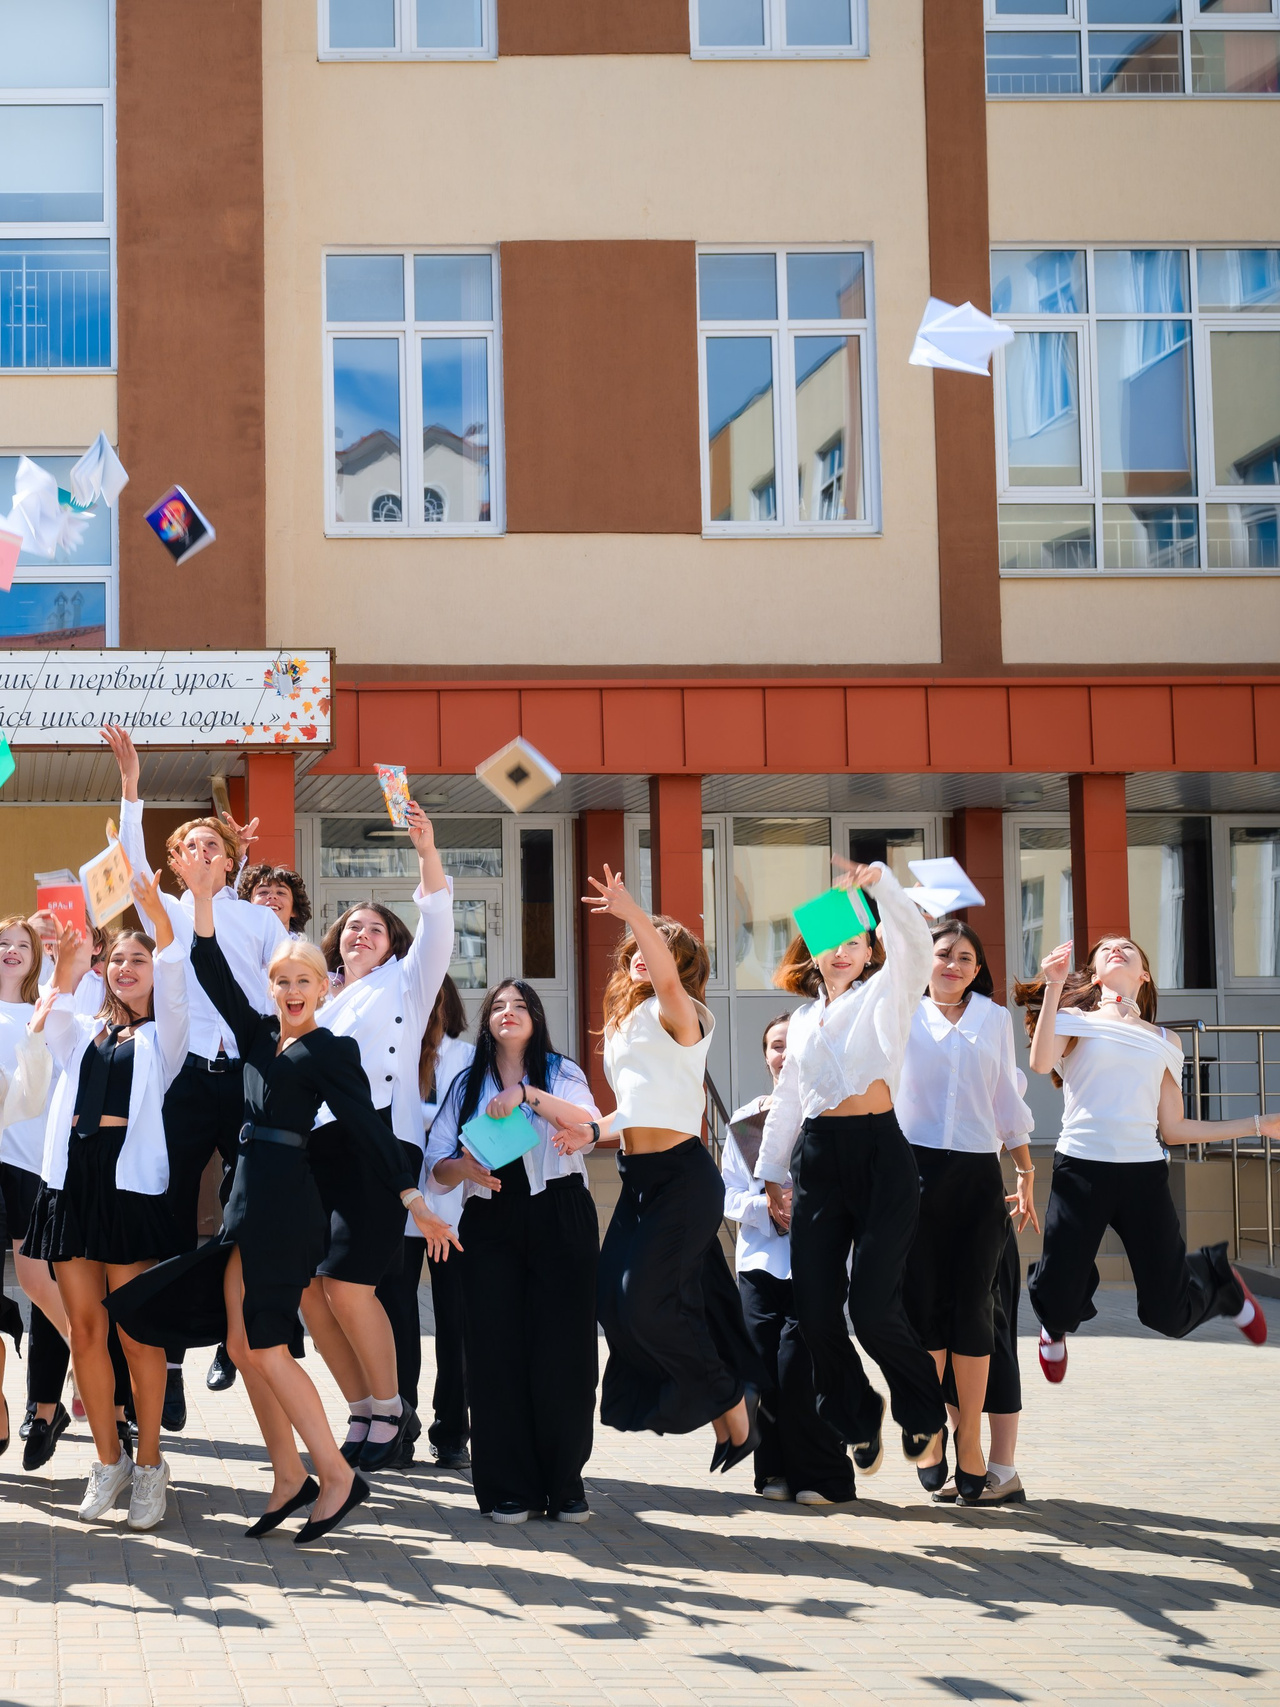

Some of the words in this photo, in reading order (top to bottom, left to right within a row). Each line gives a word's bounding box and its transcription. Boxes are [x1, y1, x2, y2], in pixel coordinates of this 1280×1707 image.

[45, 673, 63, 689] и
[70, 665, 169, 696] первый
[172, 672, 238, 696] урок
[40, 710, 177, 731] школьные
